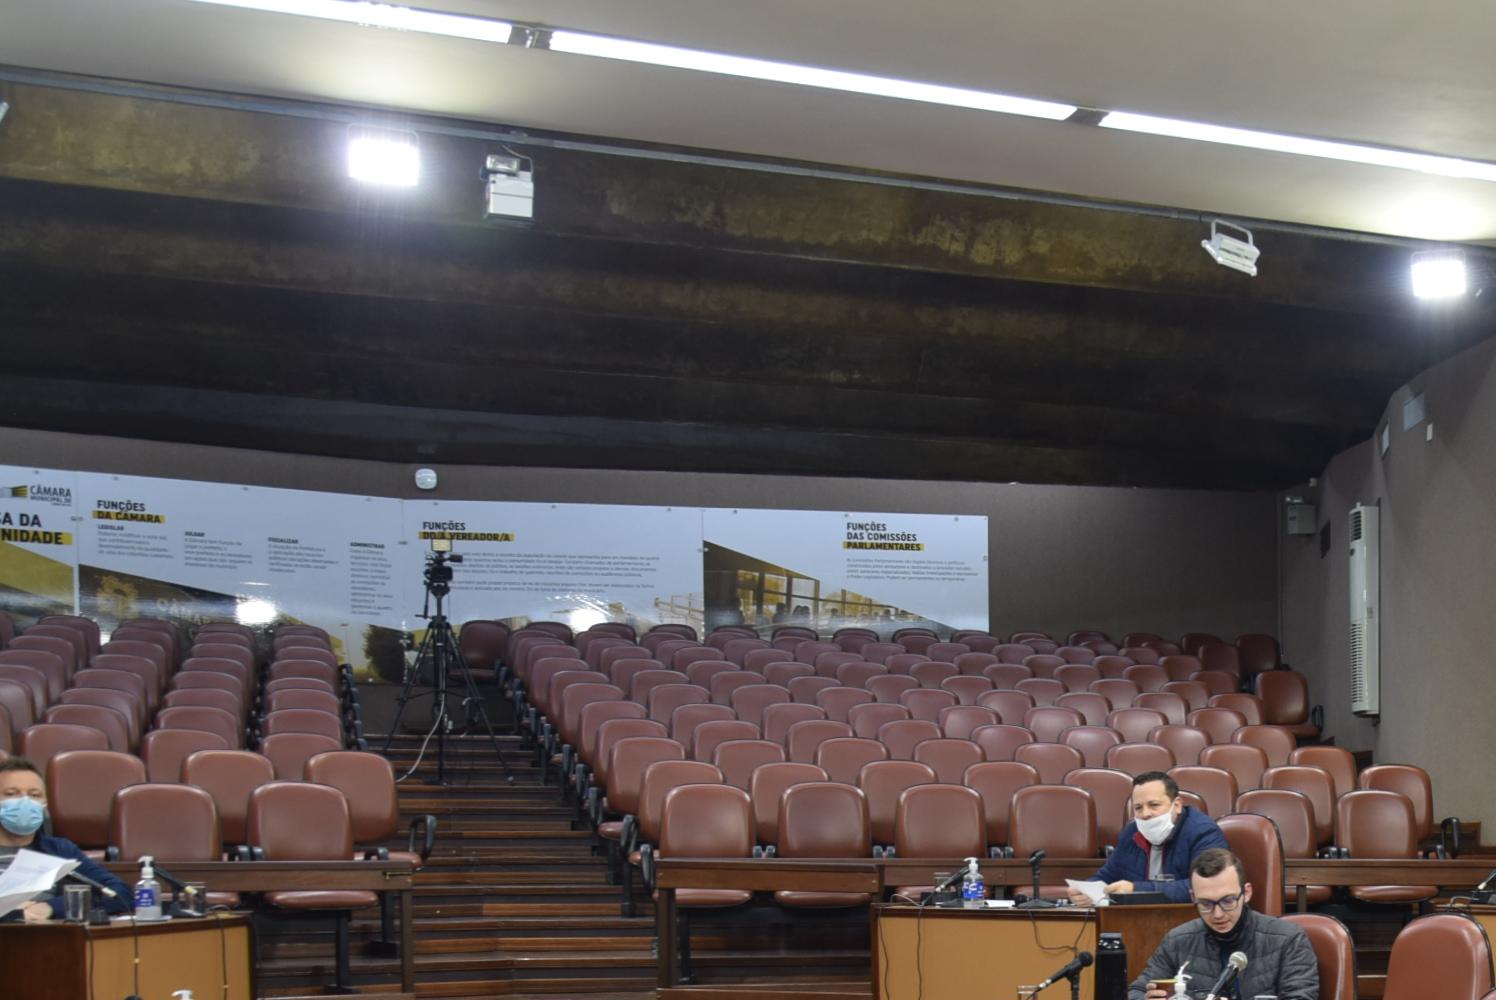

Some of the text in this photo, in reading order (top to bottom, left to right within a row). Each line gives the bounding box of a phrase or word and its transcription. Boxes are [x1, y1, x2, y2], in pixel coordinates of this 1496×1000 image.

[30, 484, 72, 498] CÂMARA
[97, 499, 146, 514] FUNÇÕES
[19, 513, 42, 528] DA
[97, 510, 162, 523] DA CÂMARA
[423, 520, 466, 531] FUNÇÕES
[846, 521, 887, 533] FUNÇÕES
[449, 531, 512, 542] VEREADOR/A
[846, 531, 918, 542] DAS COMISSÕES
[846, 541, 921, 552] PARLAMENTARES
